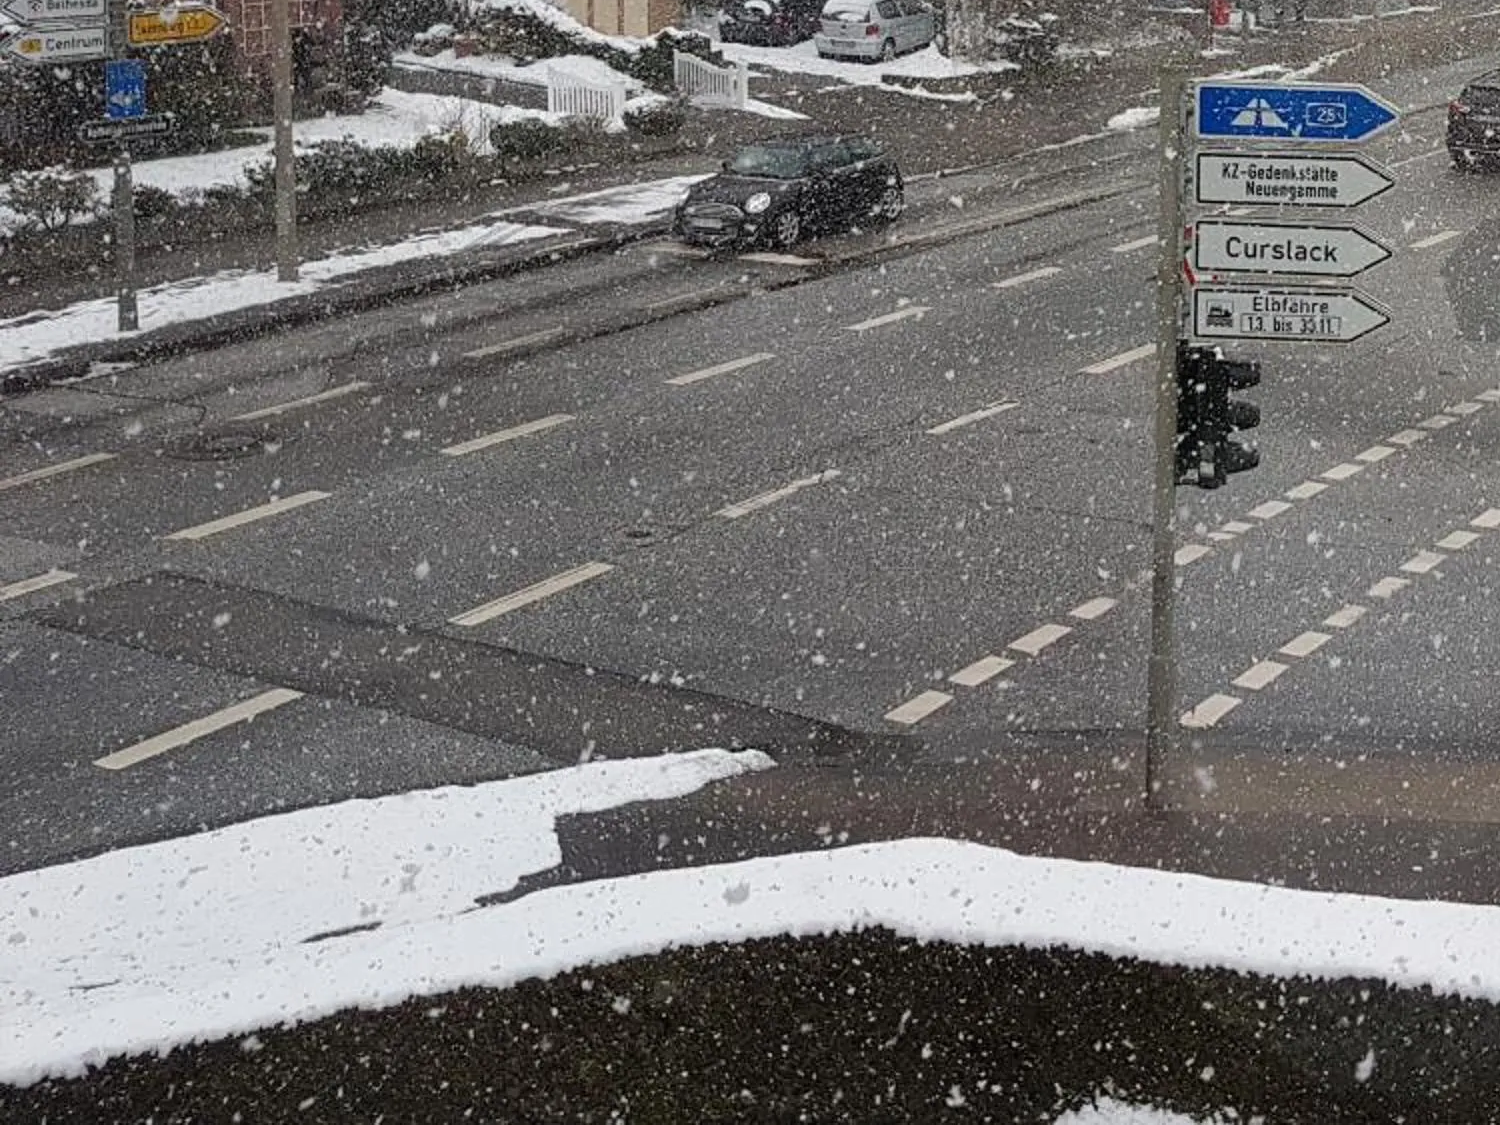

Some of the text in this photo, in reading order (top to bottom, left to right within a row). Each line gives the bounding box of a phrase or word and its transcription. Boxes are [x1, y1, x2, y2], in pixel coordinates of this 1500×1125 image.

[45, 36, 103, 52] Centrum
[1317, 106, 1336, 122] 25
[1221, 162, 1339, 182] KZ-Gedenkstätte
[1245, 180, 1339, 201] Neuengamme
[1225, 236, 1338, 263] Curslack
[1252, 296, 1329, 314] Elbfähre
[1273, 316, 1293, 332] bis
